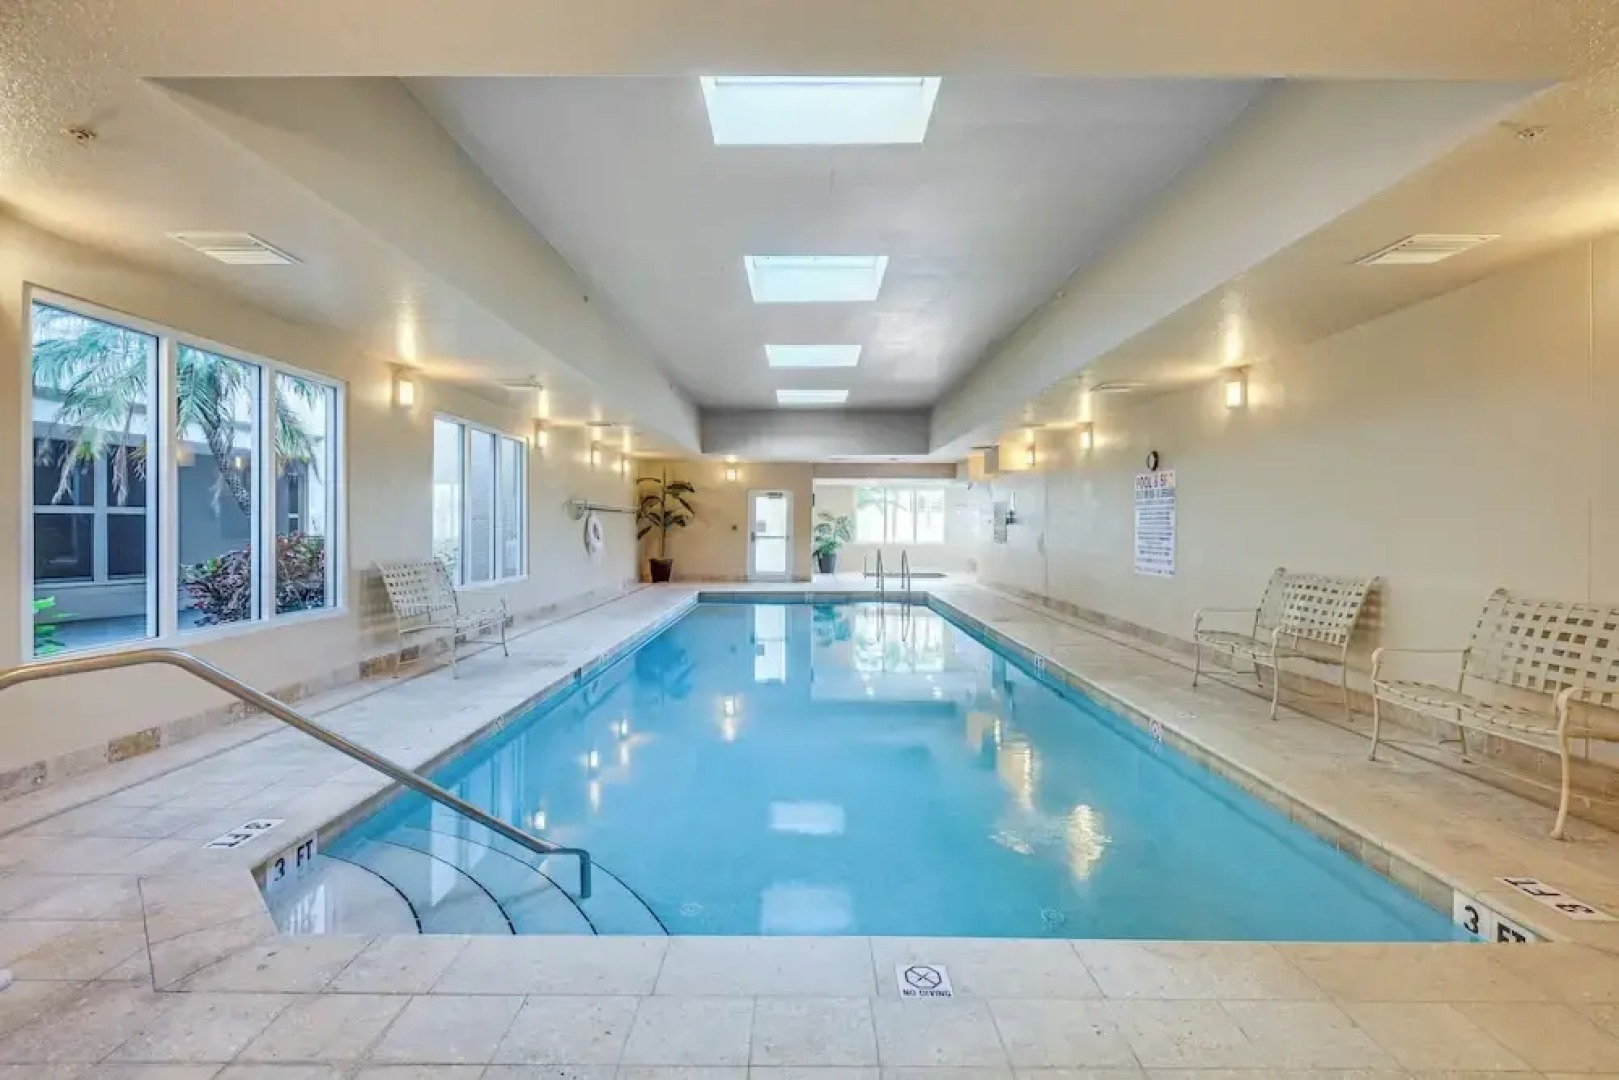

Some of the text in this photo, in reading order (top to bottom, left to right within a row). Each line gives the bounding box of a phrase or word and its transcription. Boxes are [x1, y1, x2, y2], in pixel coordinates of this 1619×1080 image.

[207, 821, 272, 848] 3 FT
[274, 839, 313, 882] 3 FT
[1503, 877, 1595, 914] 3 FT
[1463, 905, 1479, 934] 3
[902, 988, 917, 997] NO
